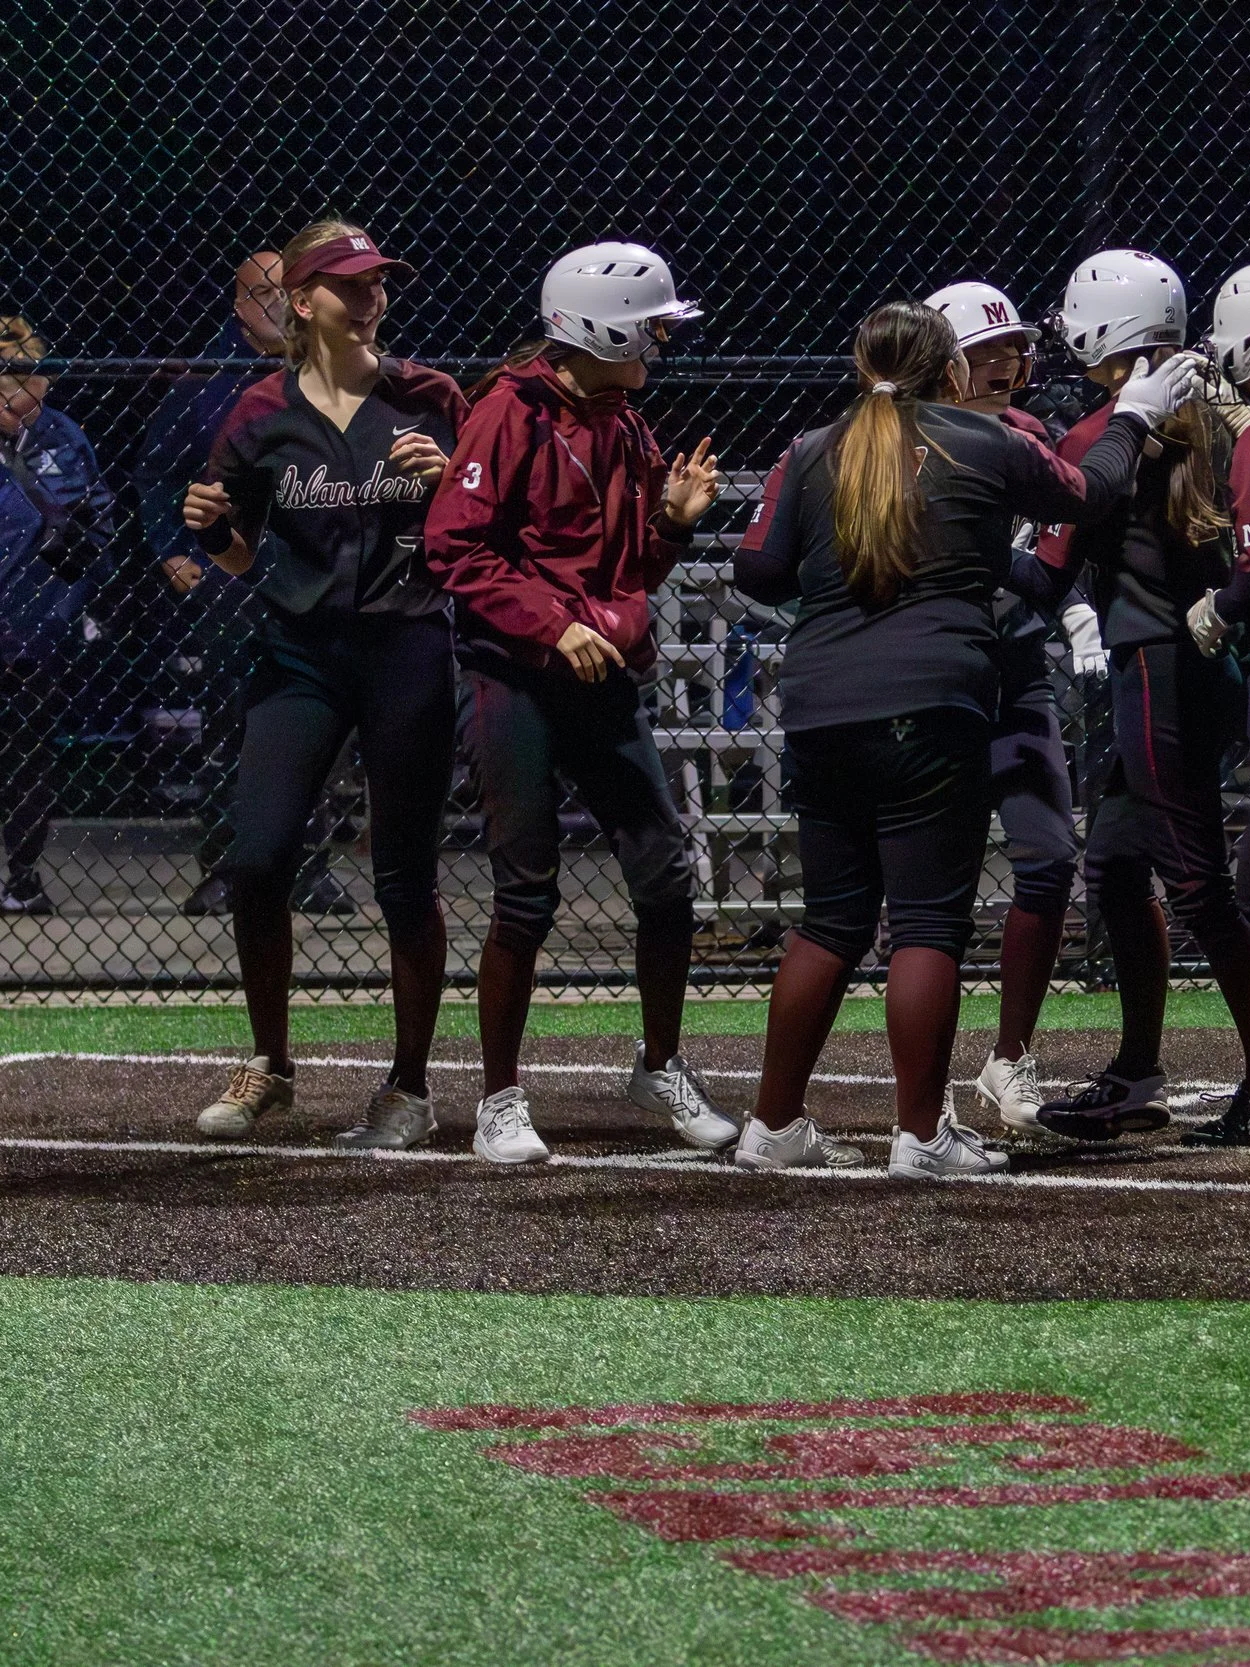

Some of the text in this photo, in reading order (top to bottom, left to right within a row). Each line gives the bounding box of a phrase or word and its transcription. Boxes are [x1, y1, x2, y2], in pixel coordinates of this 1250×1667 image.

[1165, 306, 1176, 324] 2
[275, 460, 426, 509] Islanders
[462, 462, 482, 489] 3
